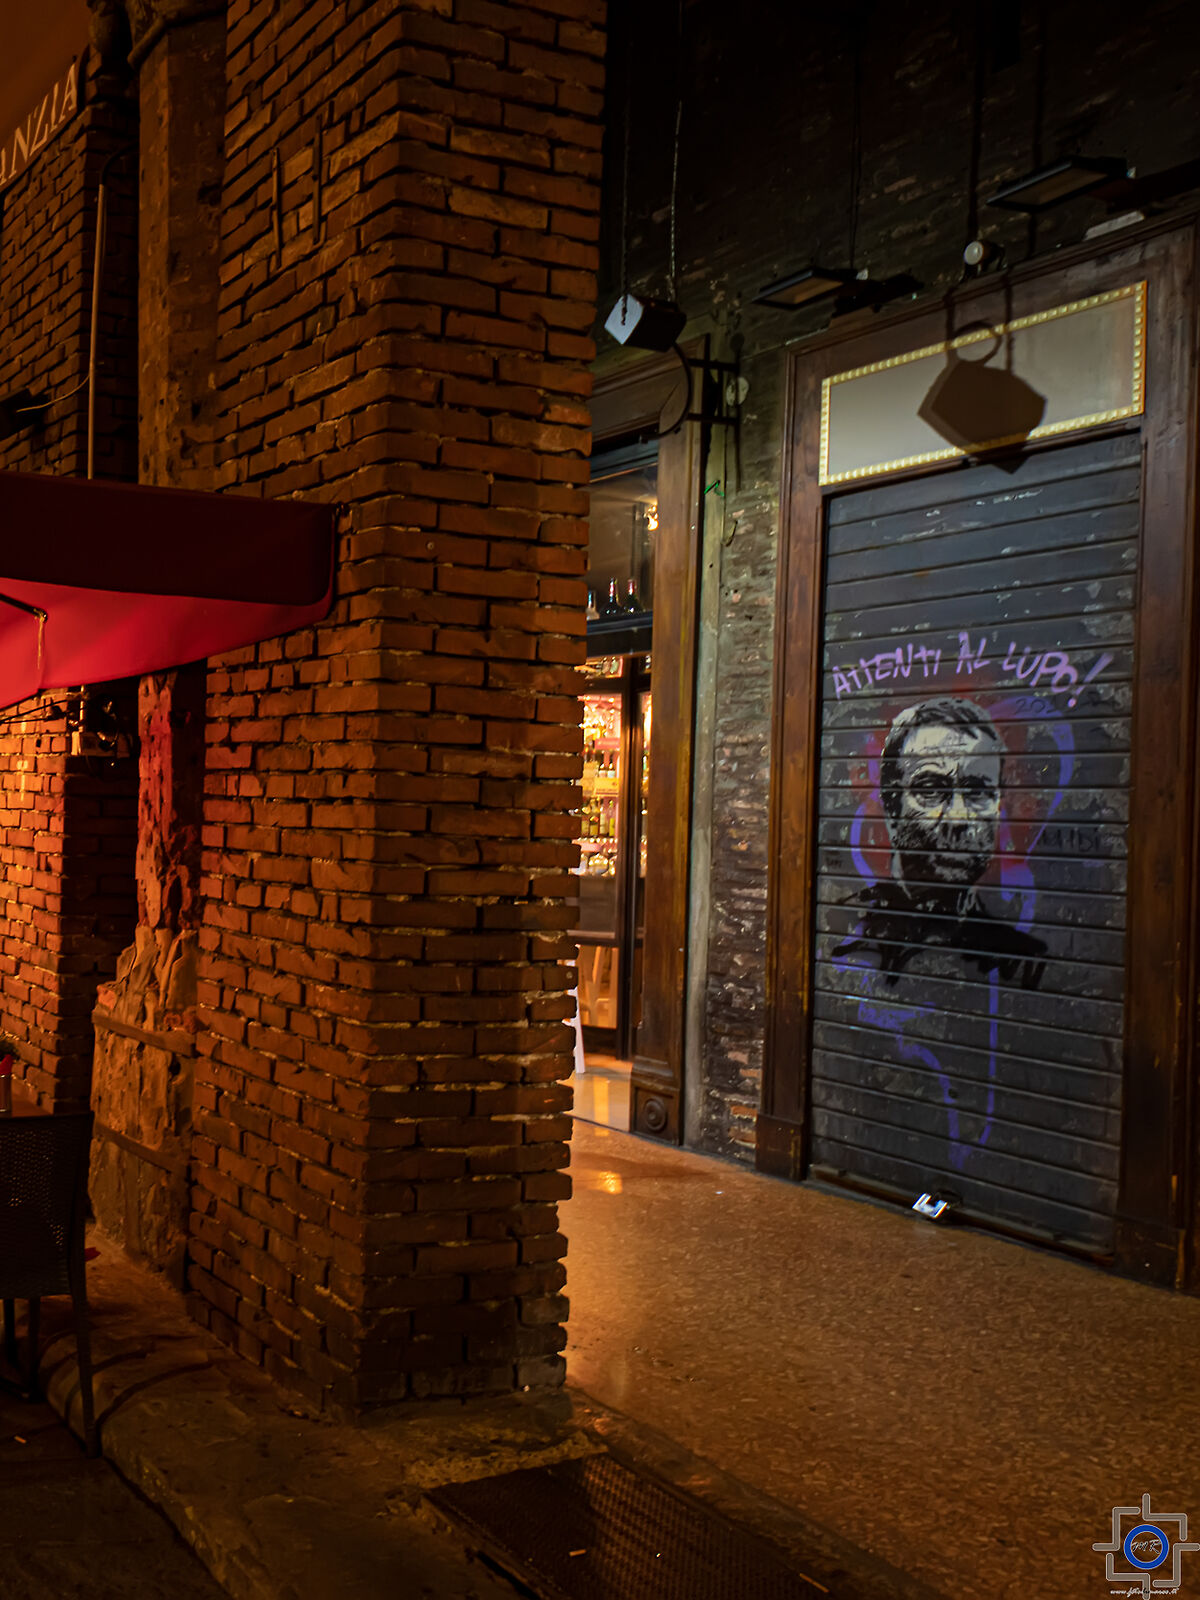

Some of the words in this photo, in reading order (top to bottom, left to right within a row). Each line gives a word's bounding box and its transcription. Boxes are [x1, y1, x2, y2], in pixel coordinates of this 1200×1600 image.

[832, 643, 942, 700] ATTENTI
[956, 632, 991, 674] AL
[1002, 642, 1114, 708] LUPO!
